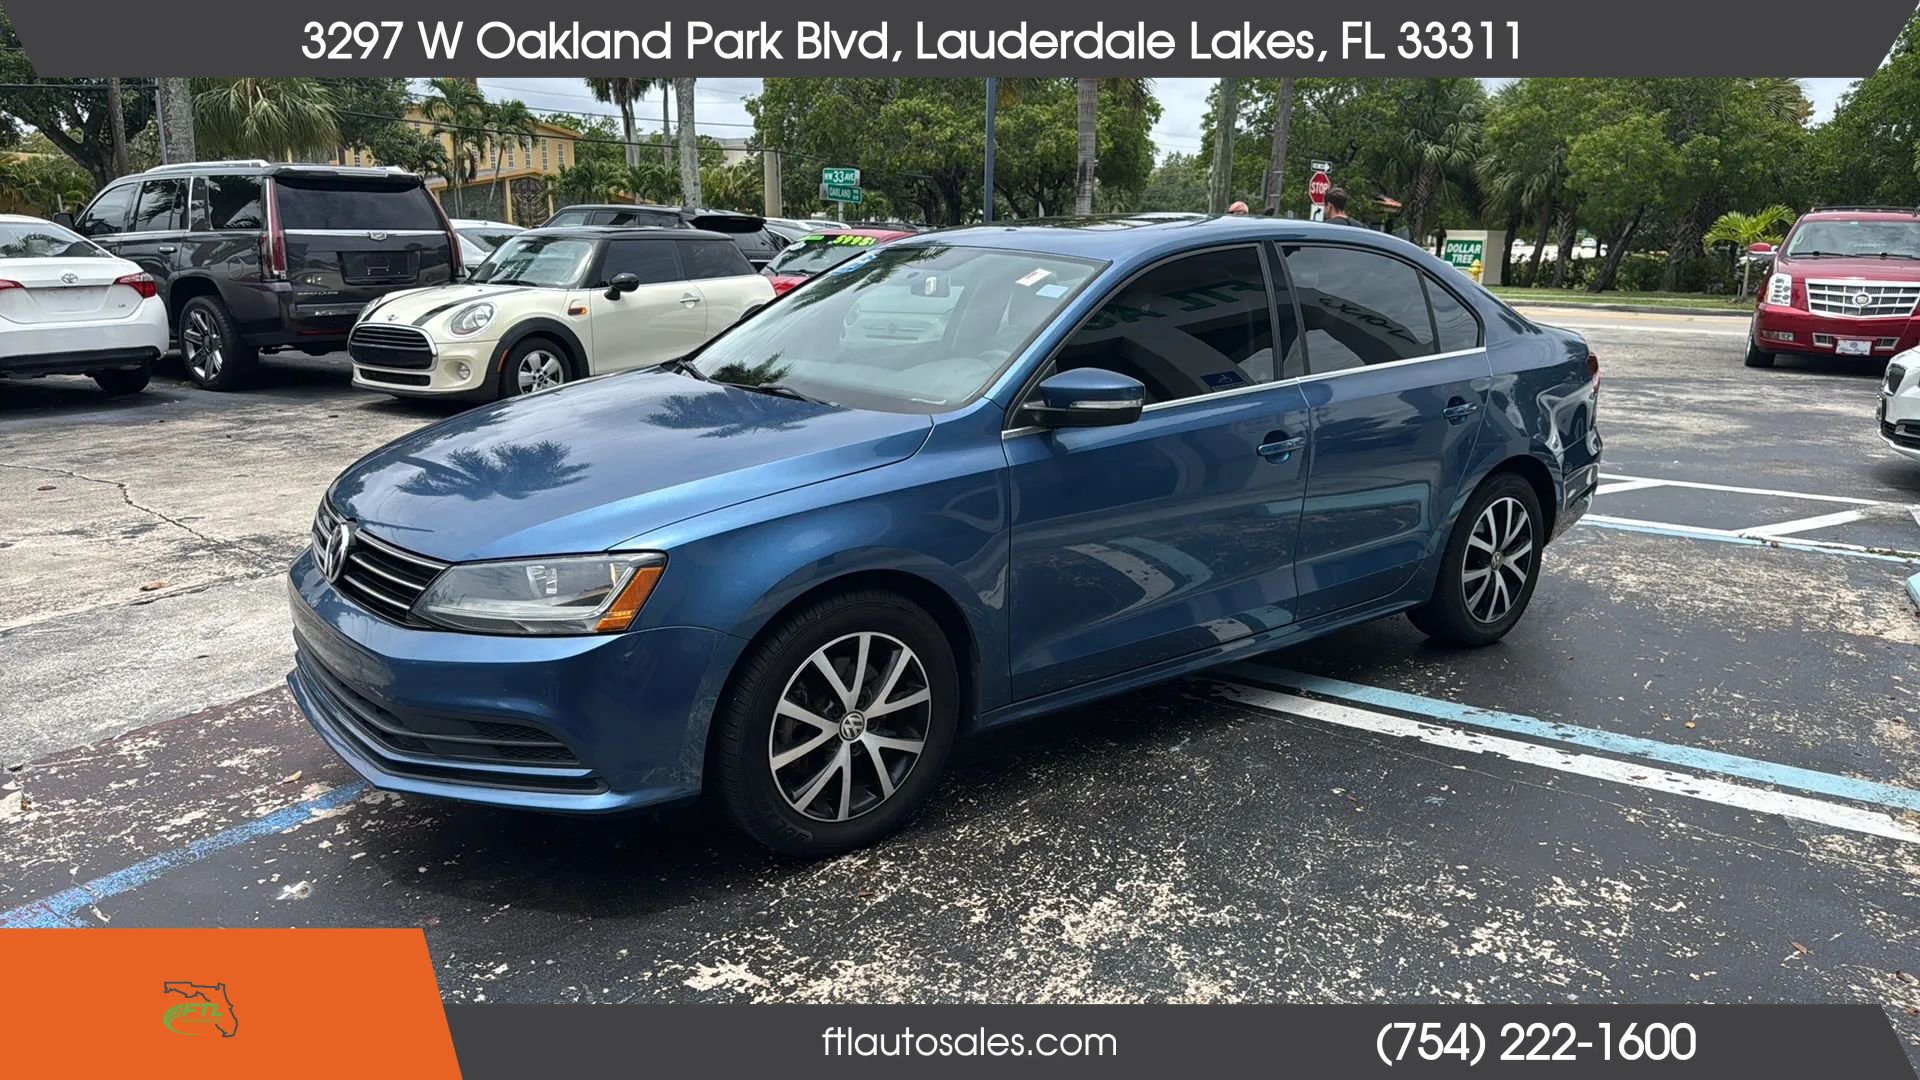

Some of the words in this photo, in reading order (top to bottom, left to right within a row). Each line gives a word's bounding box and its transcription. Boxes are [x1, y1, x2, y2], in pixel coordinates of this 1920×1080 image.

[832, 170, 844, 183] 33
[844, 172, 855, 182] AVE
[829, 187, 852, 198] OAKLAND
[1311, 182, 1328, 194] STOP
[1446, 243, 1482, 254] DOLLAR
[1451, 254, 1475, 264] TREE
